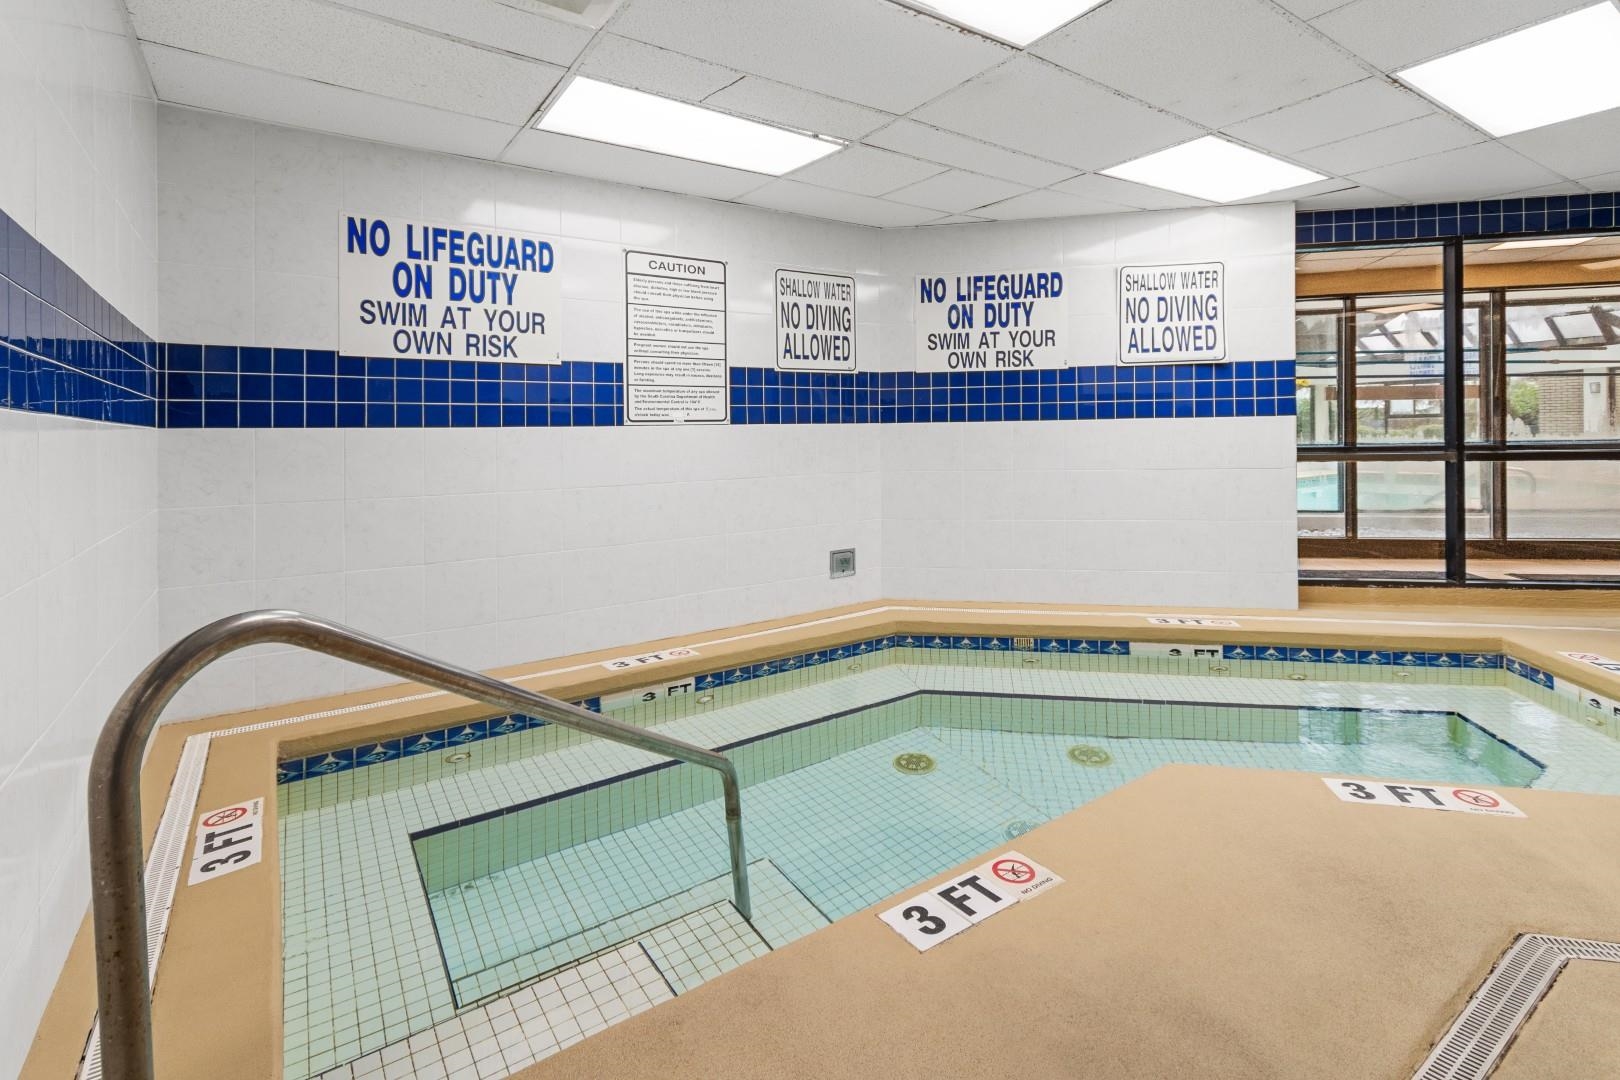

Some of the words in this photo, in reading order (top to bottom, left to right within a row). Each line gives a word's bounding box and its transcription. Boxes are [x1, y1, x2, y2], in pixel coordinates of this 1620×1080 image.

[347, 216, 390, 257] NO
[407, 224, 554, 273] LIFEGUARD
[649, 260, 705, 275] CAUTION
[1126, 272, 1176, 291] SHALLOW
[1181, 271, 1218, 289] WATER
[392, 261, 433, 299] ON
[449, 267, 518, 305] DUTY
[780, 277, 820, 299] SHALLOW
[824, 282, 851, 301] WATER
[920, 278, 946, 303] NO
[957, 272, 1063, 301] LIFEGUARD
[360, 299, 427, 327] SWIM
[440, 306, 471, 330] AT
[484, 309, 545, 334] YOUR
[781, 301, 800, 329] NO
[806, 304, 851, 332] DIVING
[948, 304, 973, 329] ON
[985, 301, 1034, 328] DUTY
[1126, 297, 1149, 323] NO
[1157, 294, 1217, 322] DIVING
[393, 329, 452, 355] OWN
[466, 333, 518, 358] RISK
[783, 333, 850, 361] ALLOWED
[928, 332, 970, 350] SWIM
[979, 331, 1000, 348] AT
[1009, 330, 1055, 348] YOUR
[1128, 325, 1216, 353] ALLOWED
[948, 351, 986, 369] OWN
[996, 350, 1034, 367] RISK
[635, 654, 664, 664] FT
[1169, 648, 1182, 657] 3
[1194, 648, 1219, 658] FT
[642, 691, 656, 702] 3
[668, 683, 692, 697] FT
[1341, 782, 1377, 800] 3
[1383, 784, 1446, 806] FT
[203, 823, 253, 855] FT
[200, 850, 251, 873] 3
[902, 905, 947, 936] 3
[937, 874, 1003, 917] FT
